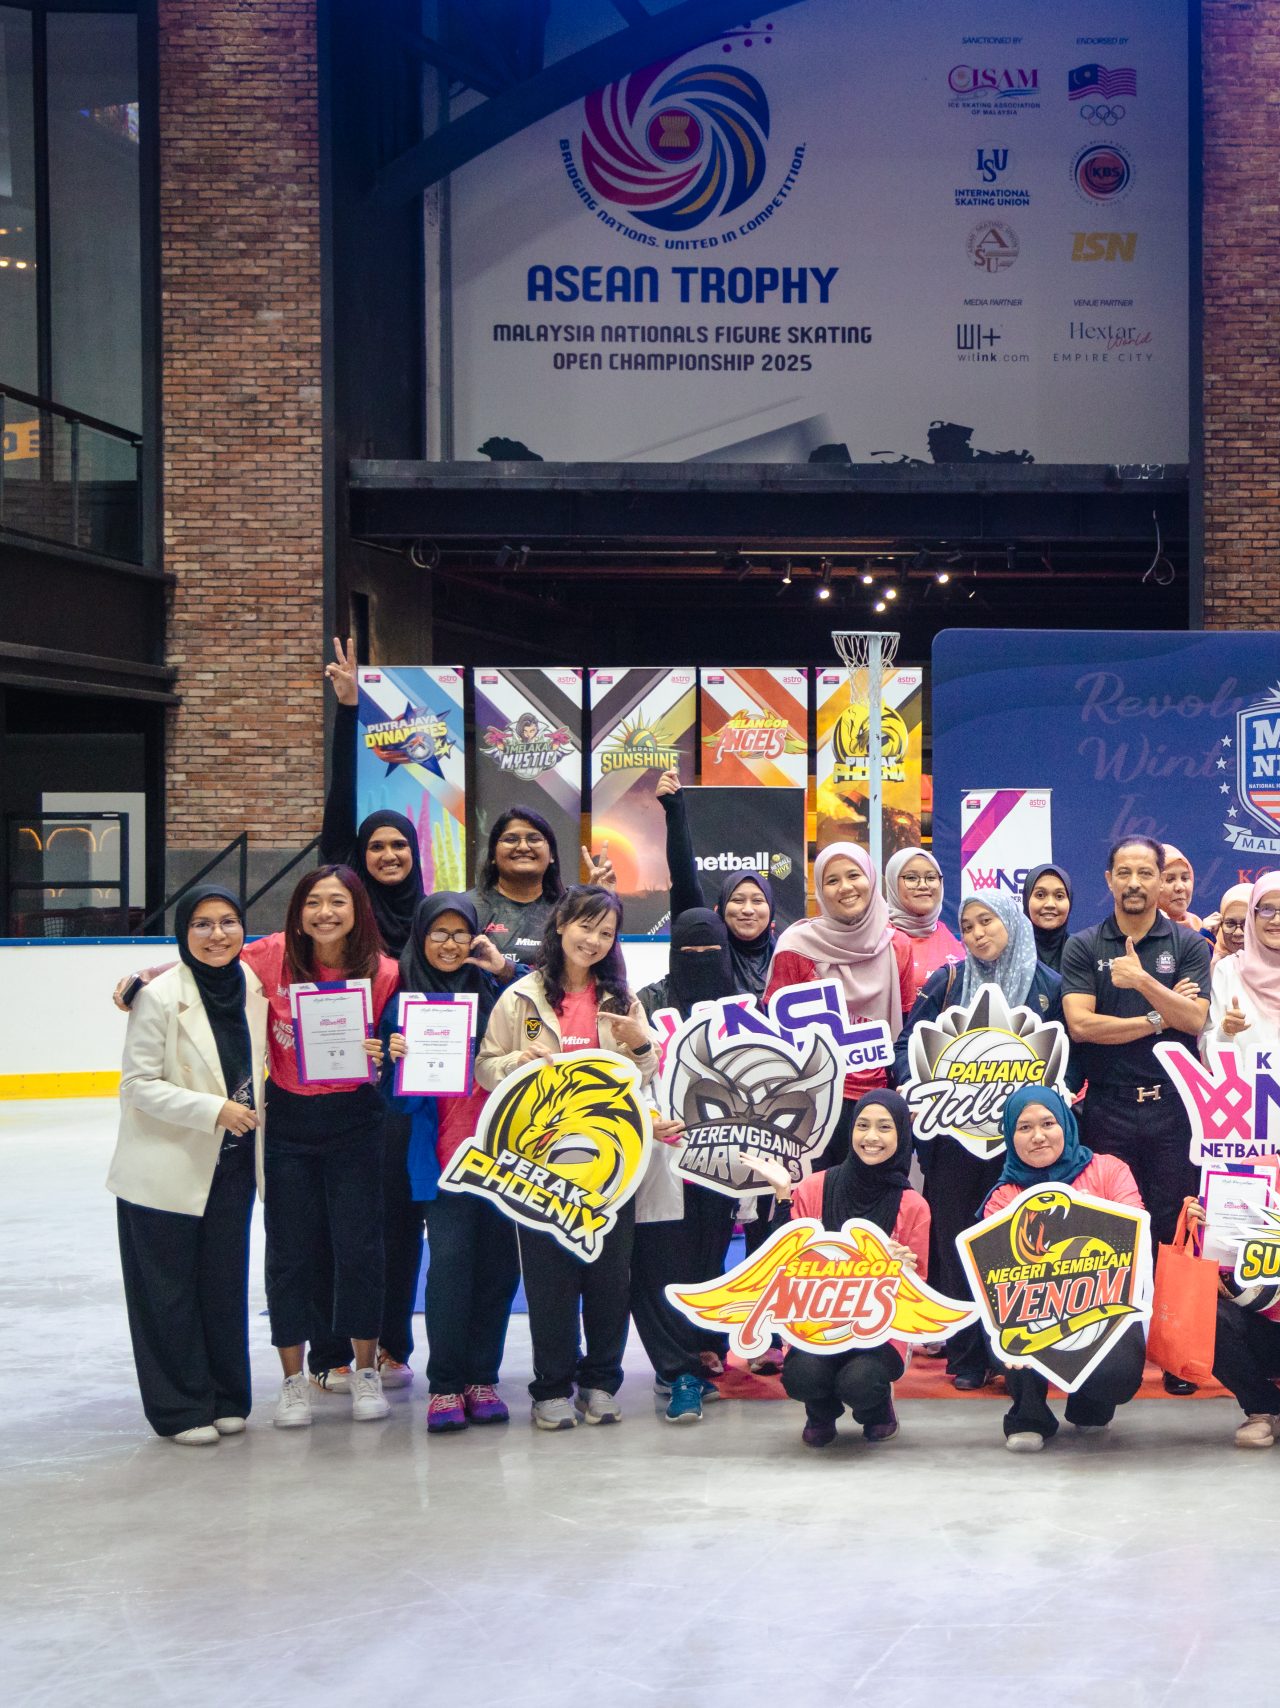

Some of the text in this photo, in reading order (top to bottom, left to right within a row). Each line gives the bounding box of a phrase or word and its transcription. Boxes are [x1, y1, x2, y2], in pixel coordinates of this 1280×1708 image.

[559, 138, 597, 210] BRIDGING
[664, 237, 719, 251] UNITED
[721, 229, 738, 245] IN
[955, 189, 1030, 198] INTERNATIONAL
[955, 198, 1030, 206] SKATING UNION
[1071, 231, 1138, 262] ISN
[527, 264, 839, 304] ASEAN TROPHY
[493, 324, 872, 345] MALAYSIA NATIONALS FIGURE SKATING
[553, 352, 812, 372] OPEN CHAMPIONSHIP 2025
[1053, 353, 1153, 363] EMPIRE CITY
[438, 674, 458, 682] astro
[557, 675, 577, 683] astro
[783, 675, 802, 683] astro
[366, 715, 439, 732] PUTRAJAYA
[727, 719, 789, 729] SELANGOR
[509, 743, 549, 752] MELAKA
[713, 728, 787, 764] ANGELS
[500, 750, 556, 770] MYSTIC
[601, 752, 678, 773] SUNSHINE
[1029, 798, 1046, 806] astro
[695, 852, 769, 871] netball
[560, 1036, 590, 1045] Mitre
[948, 1060, 1047, 1083] PAHANG
[688, 1125, 800, 1157] TERENGGANU
[495, 1149, 590, 1206] PERAK
[450, 1149, 607, 1250] PHOENIX
[784, 1259, 901, 1277] SELANGOR
[987, 1252, 1131, 1284] NEGERI SEMBILAN
[994, 1268, 1129, 1323] VENOM
[740, 1267, 900, 1348] ANGELS
